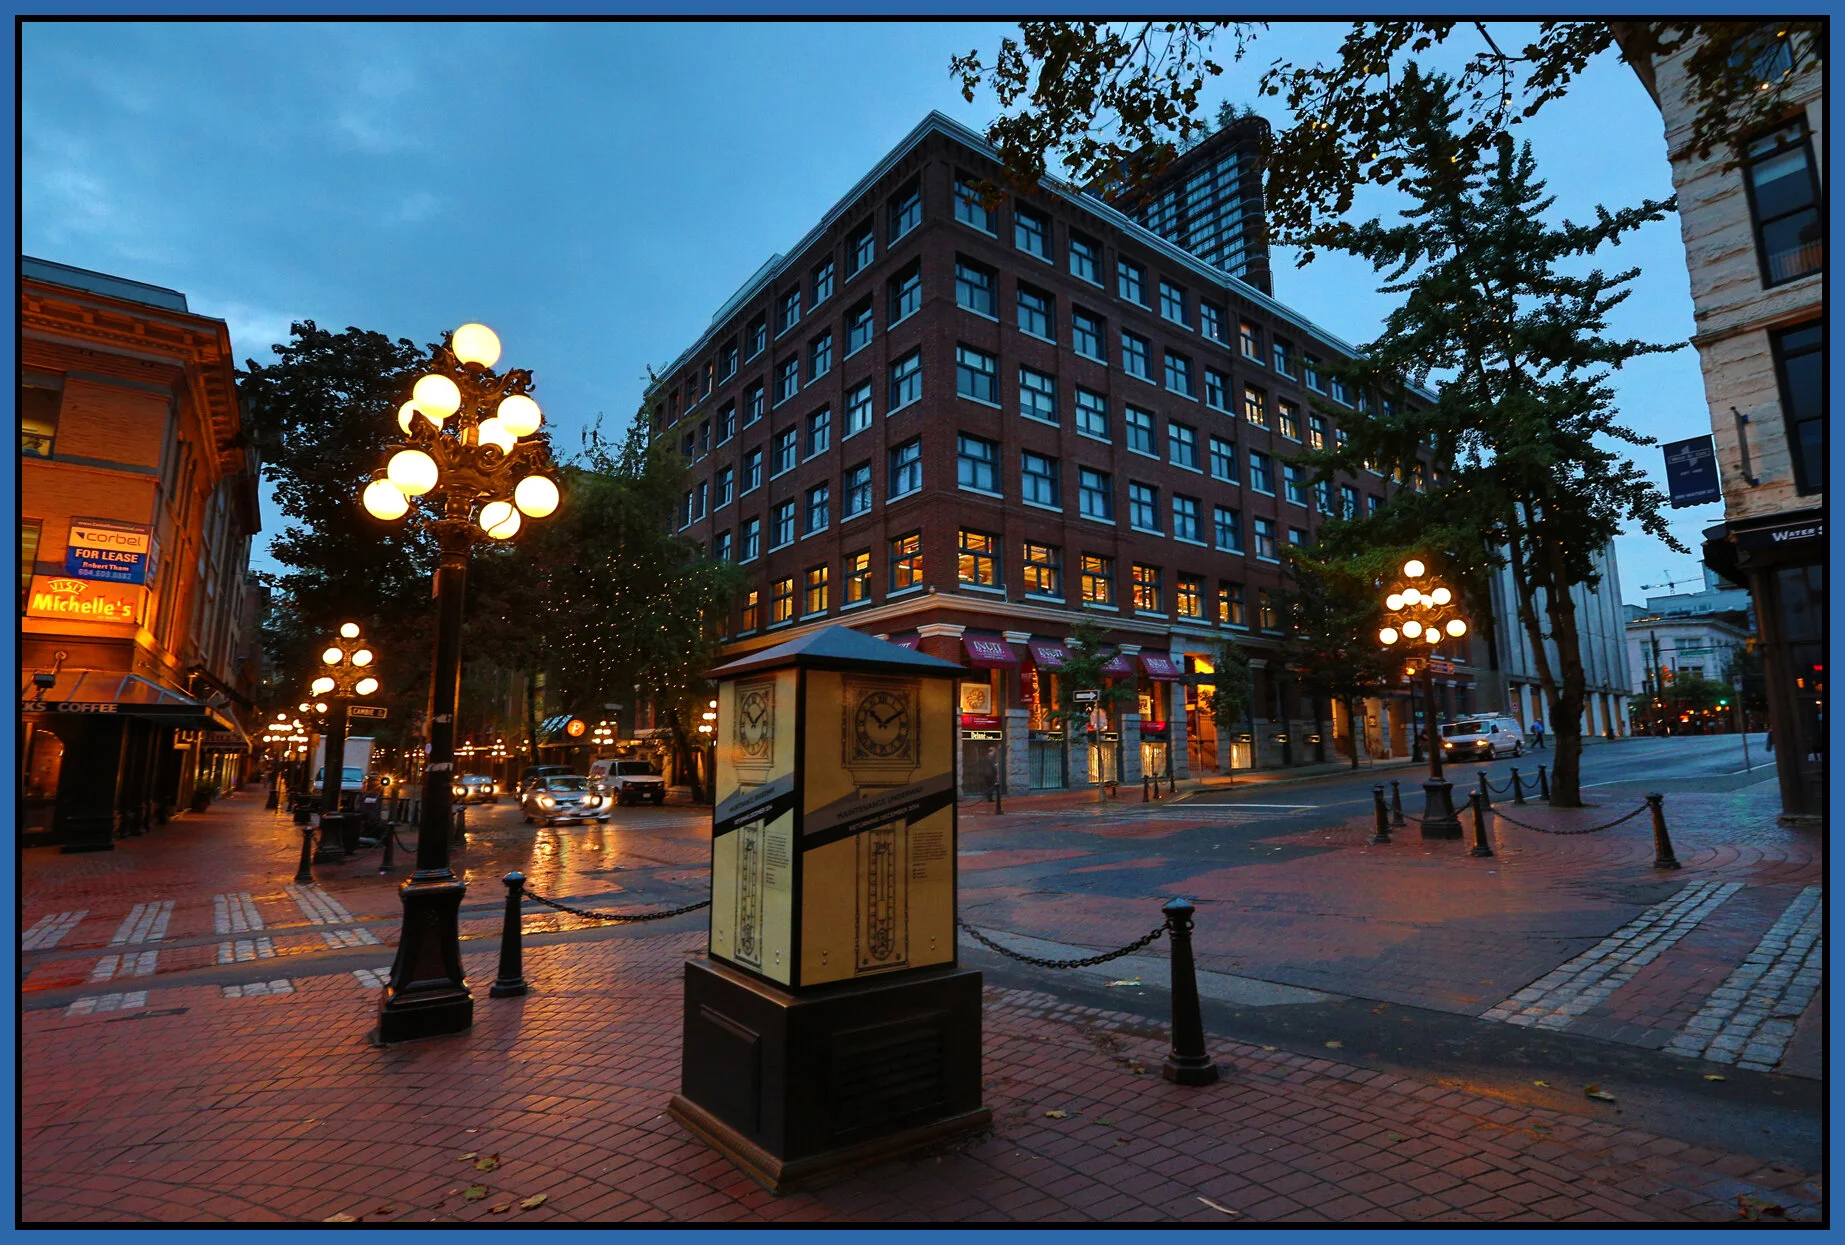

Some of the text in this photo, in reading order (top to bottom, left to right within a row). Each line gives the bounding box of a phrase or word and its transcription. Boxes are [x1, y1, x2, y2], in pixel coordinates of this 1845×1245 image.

[86, 532, 142, 547] corbel
[75, 548, 139, 564] FOR LEASE
[82, 561, 130, 572] Robert Tham
[49, 580, 87, 592] VISIT
[32, 593, 132, 617] Michelle's
[973, 640, 1003, 652] INUIT
[58, 703, 119, 713] COFFEE
[836, 797, 886, 820] MAINTENANCE
